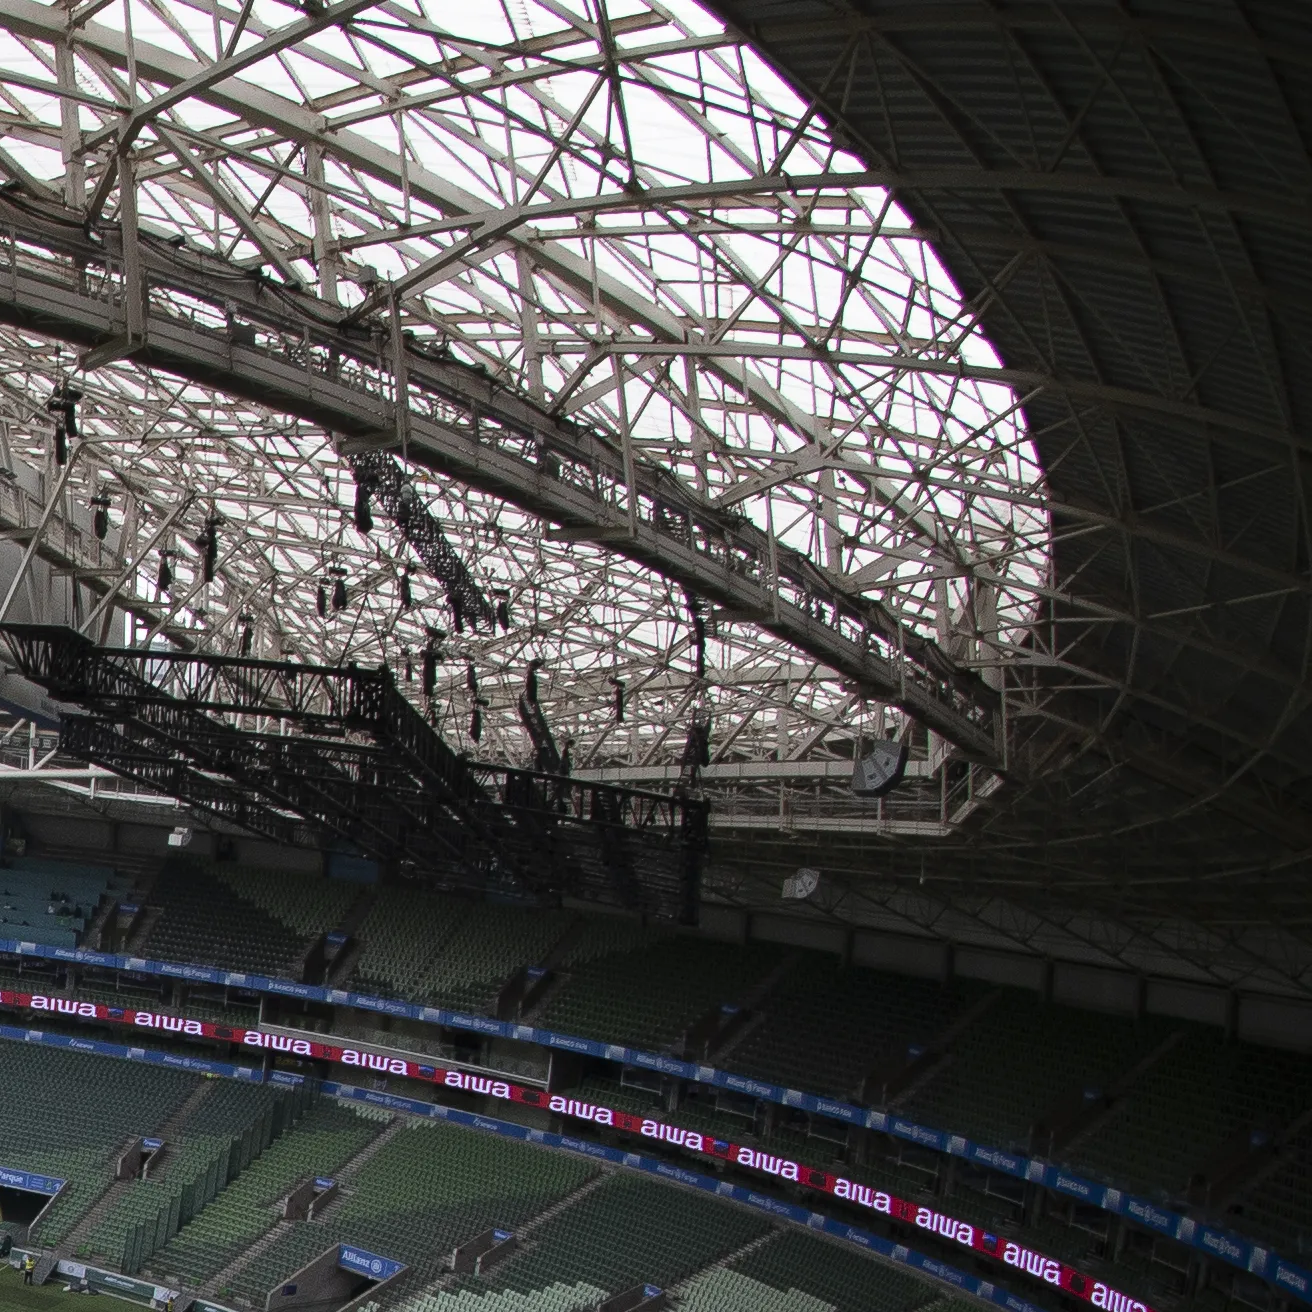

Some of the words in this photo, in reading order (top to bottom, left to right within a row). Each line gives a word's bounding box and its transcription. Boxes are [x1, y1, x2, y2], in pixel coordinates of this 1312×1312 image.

[30, 995, 97, 1018] aiwa
[134, 1011, 203, 1035] aiwa
[244, 1031, 311, 1055] aiwa
[341, 1049, 407, 1076] aiwa
[444, 1071, 510, 1099] aiwa
[549, 1095, 613, 1125] aiwa
[640, 1119, 703, 1151] aiwa
[737, 1147, 798, 1181] aiwa
[834, 1178, 890, 1214] aiwa
[915, 1207, 973, 1246] aiwa
[342, 1250, 371, 1268] Allianz
[1003, 1242, 1060, 1285] aiwa
